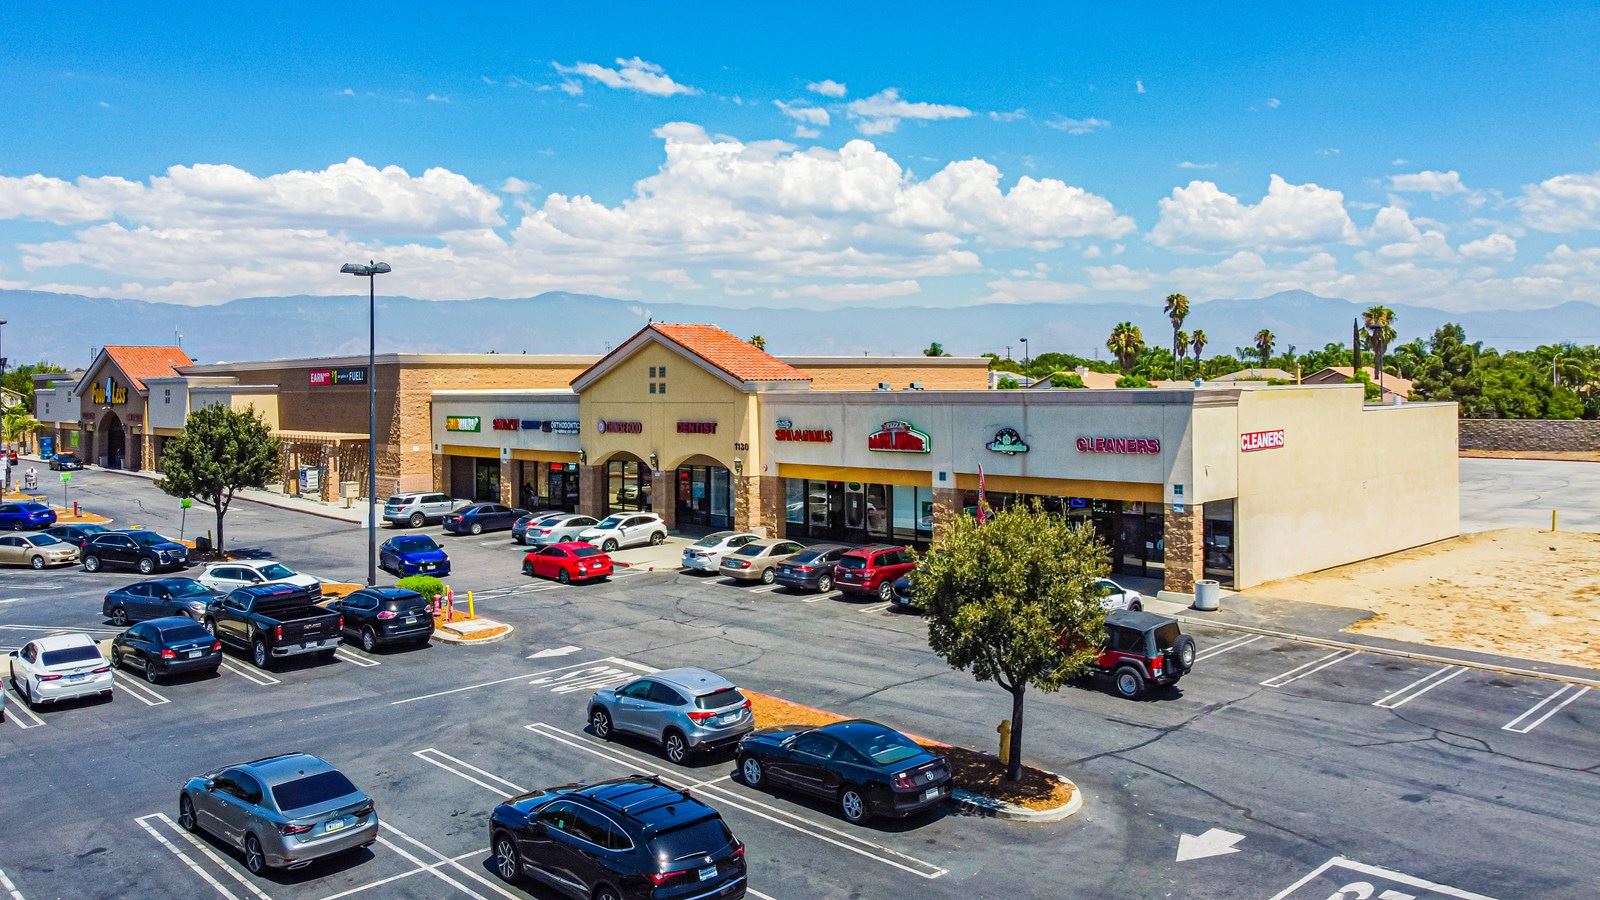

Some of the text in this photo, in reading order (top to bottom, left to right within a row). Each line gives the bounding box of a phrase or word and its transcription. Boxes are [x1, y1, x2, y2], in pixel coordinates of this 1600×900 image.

[310, 373, 324, 383] EARN
[331, 370, 338, 384] $1
[105, 377, 112, 403] 4
[676, 422, 718, 434] DENTIST
[802, 430, 833, 443] NAILS
[1241, 431, 1284, 450] CLEANERS
[734, 442, 749, 451] 1130
[1076, 437, 1160, 454] CLEANERS
